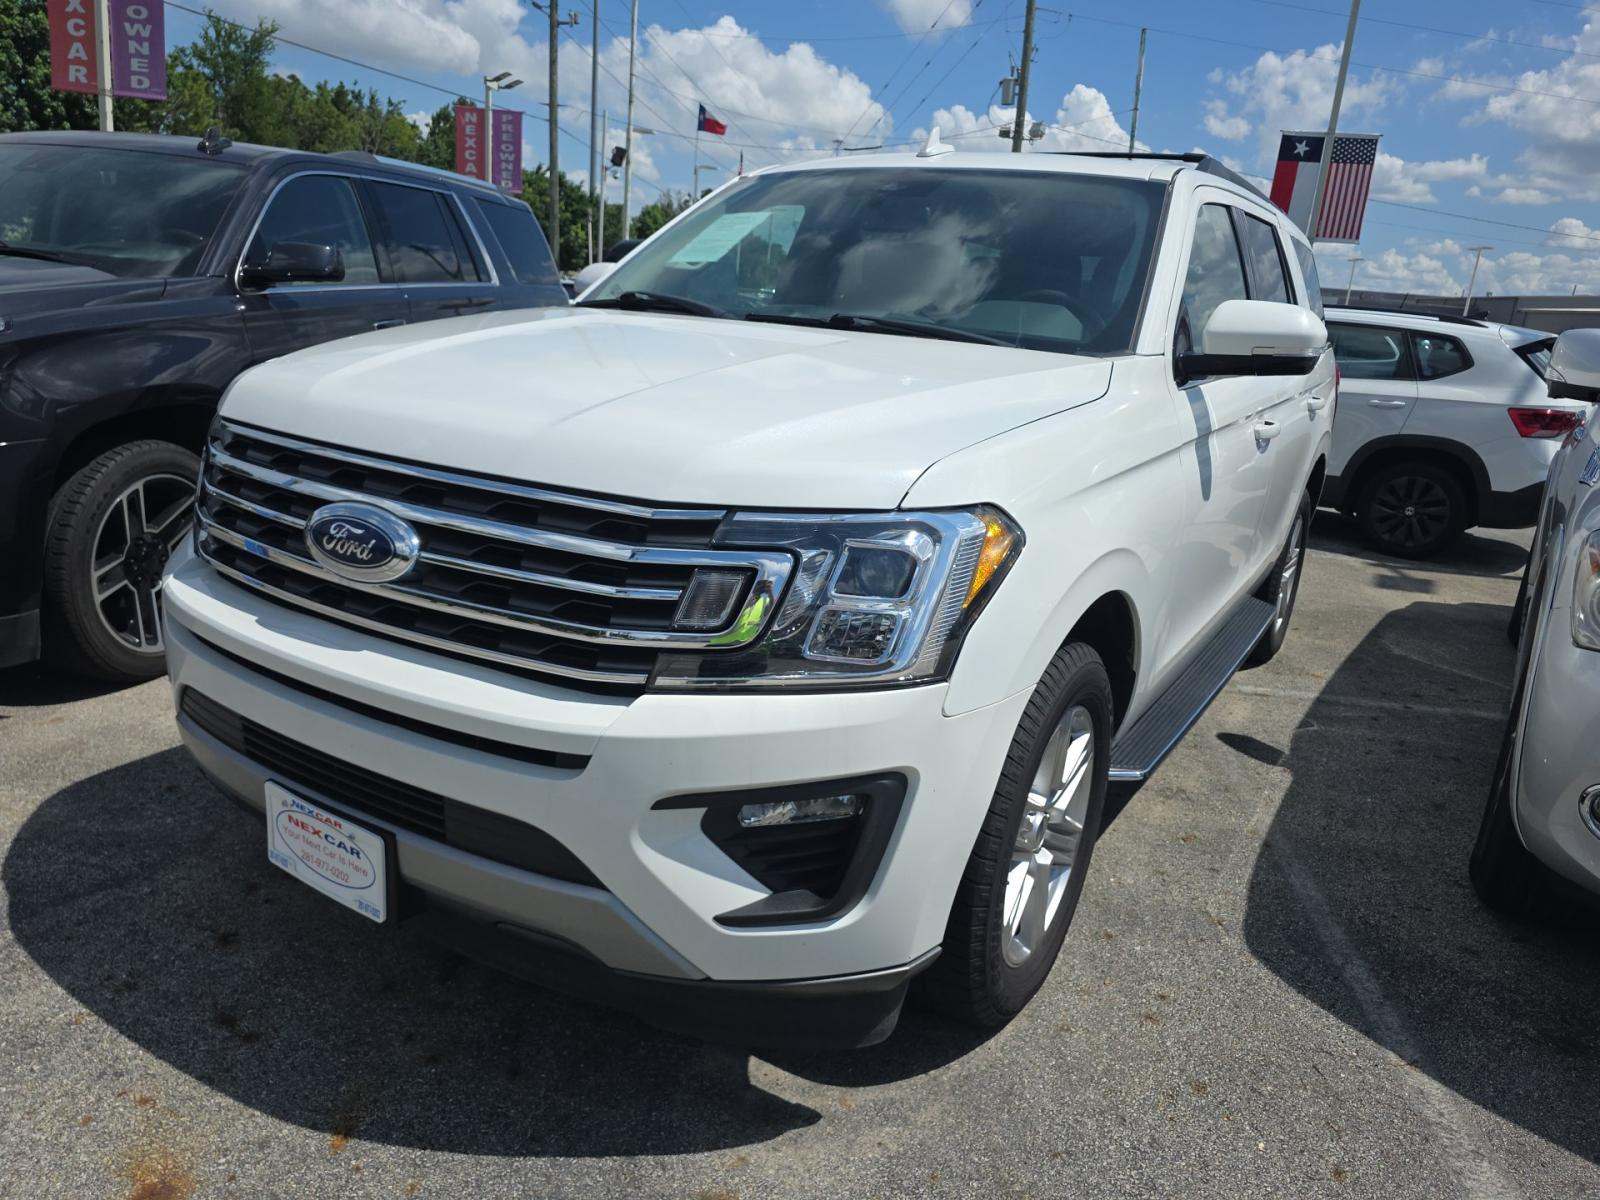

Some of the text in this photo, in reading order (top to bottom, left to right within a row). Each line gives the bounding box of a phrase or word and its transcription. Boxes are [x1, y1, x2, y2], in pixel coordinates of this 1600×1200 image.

[123, 5, 152, 89] OWNED
[464, 112, 477, 177] NEXCA
[322, 521, 377, 561] Ford
[323, 845, 337, 860] Car
